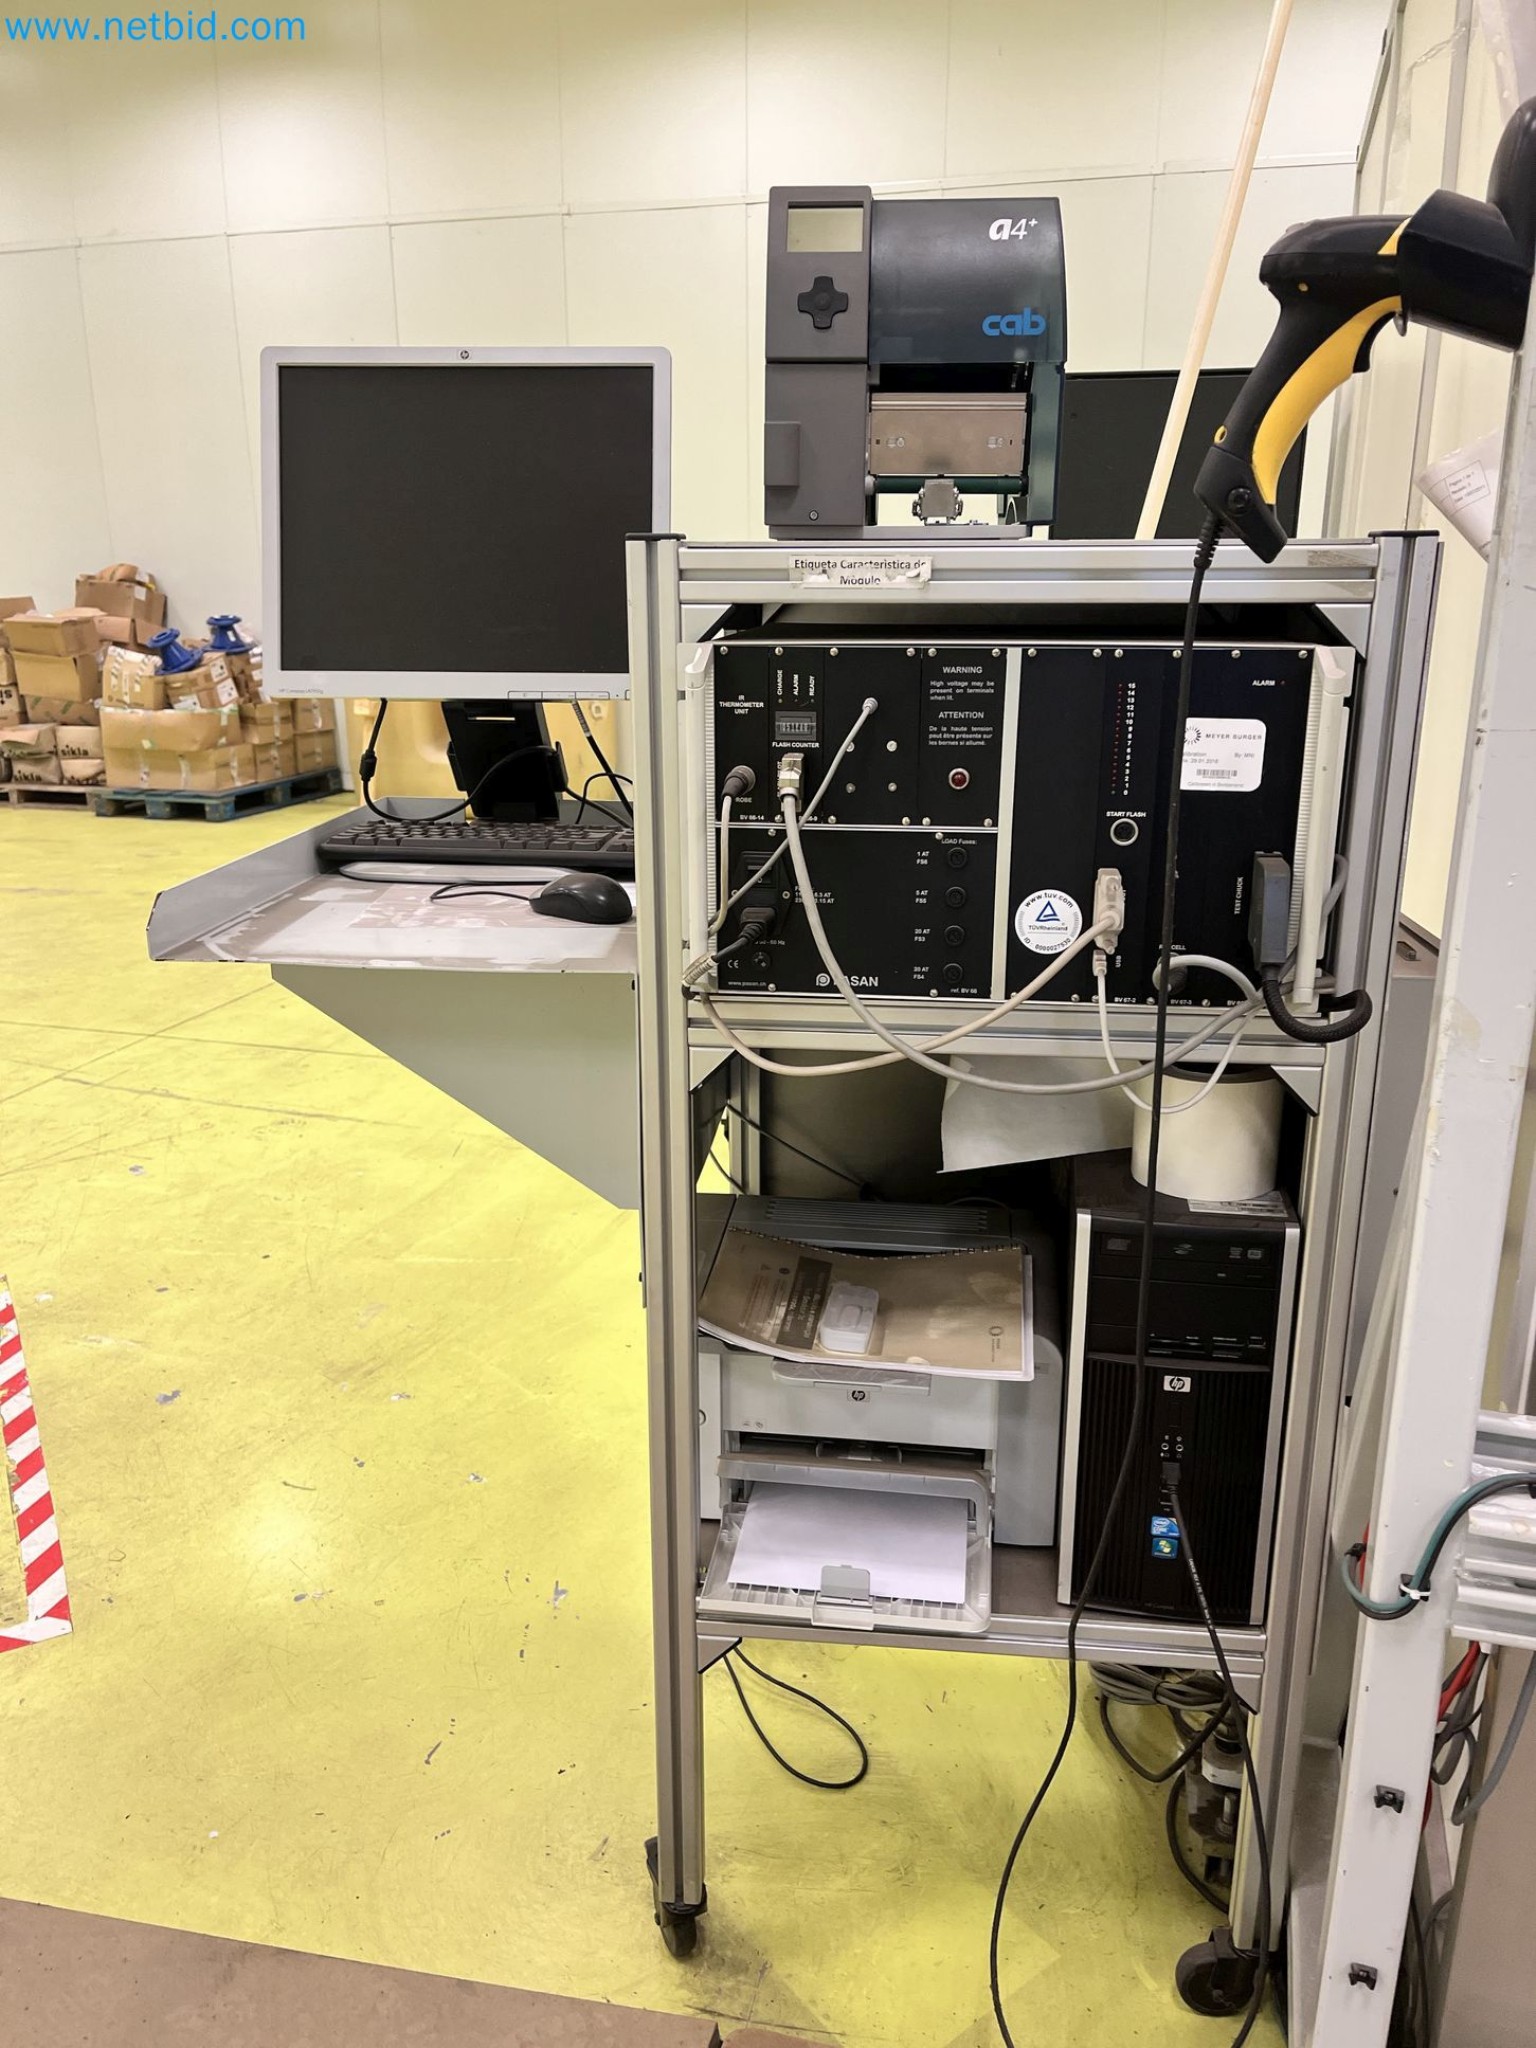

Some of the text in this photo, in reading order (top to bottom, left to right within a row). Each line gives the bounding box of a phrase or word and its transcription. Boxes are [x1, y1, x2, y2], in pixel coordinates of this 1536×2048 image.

[982, 307, 1046, 336] cab
[794, 559, 837, 571] Etiqueta
[942, 666, 983, 674] WARNING
[938, 711, 985, 719] ATTENTION
[61, 744, 89, 756] sikla
[1025, 892, 1074, 908] www.tuv.com
[1234, 876, 1244, 915] TEST CHUCK
[1168, 1376, 1186, 1391] hp
